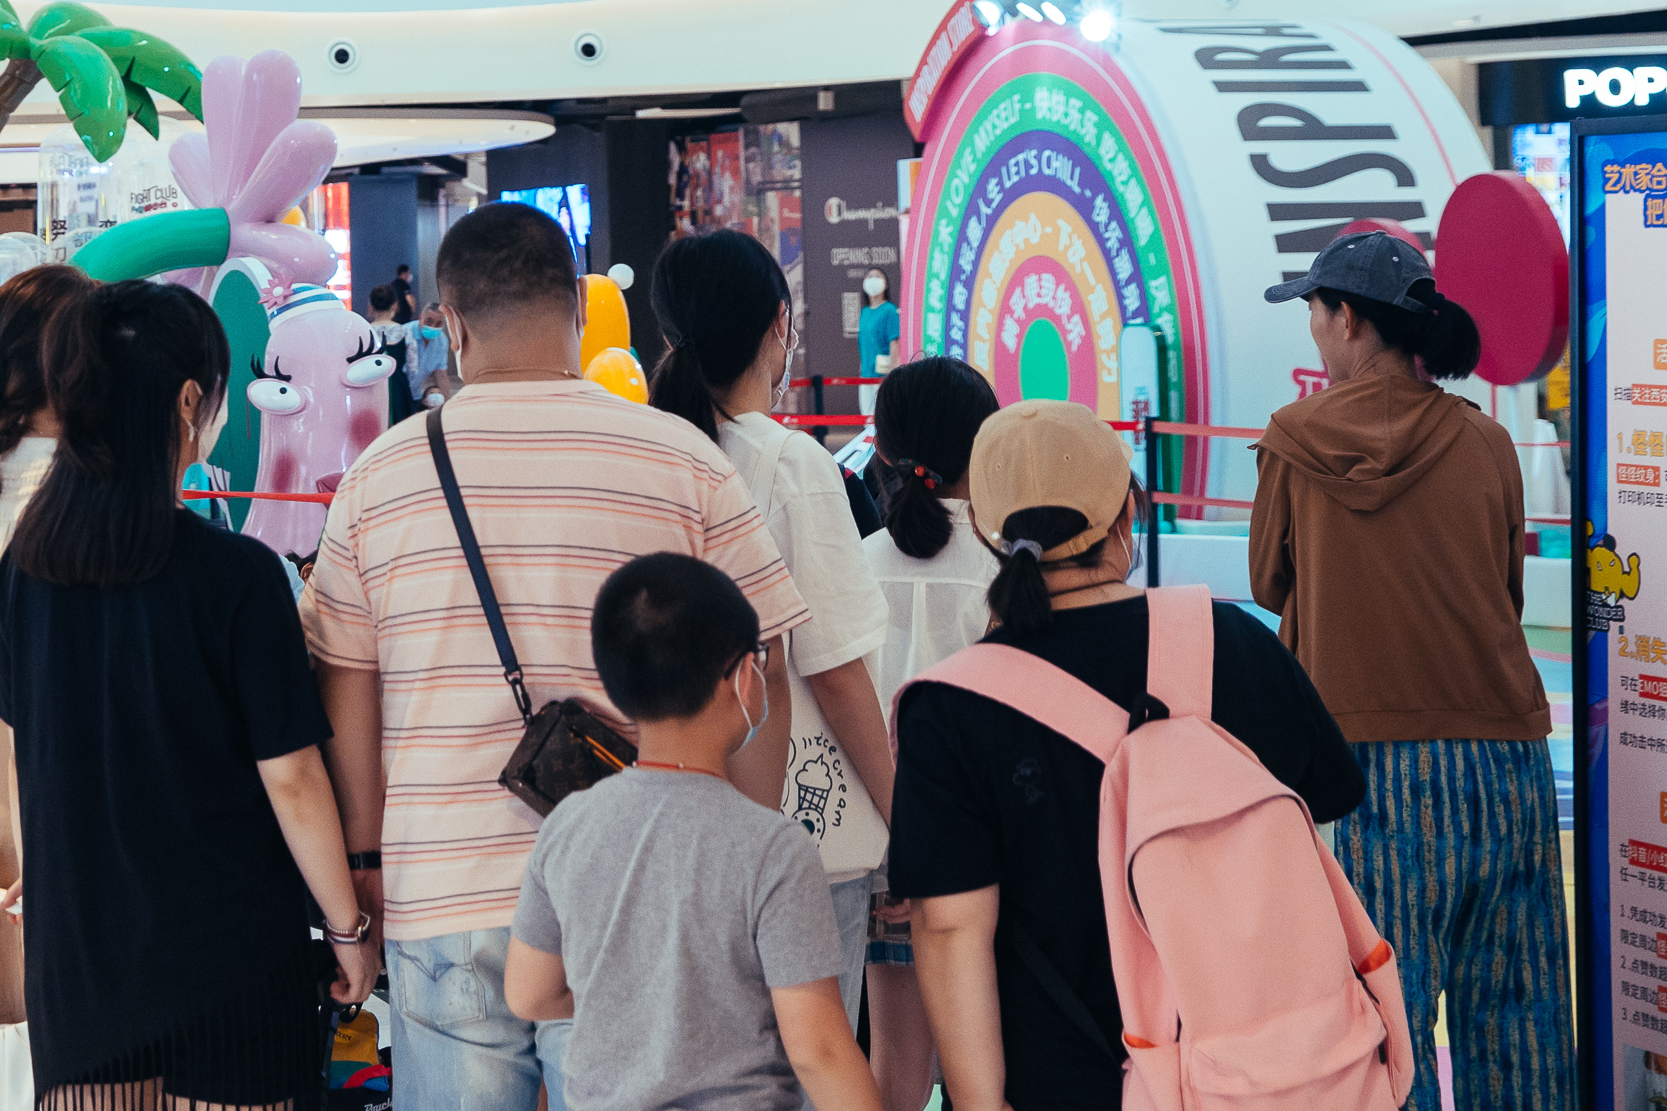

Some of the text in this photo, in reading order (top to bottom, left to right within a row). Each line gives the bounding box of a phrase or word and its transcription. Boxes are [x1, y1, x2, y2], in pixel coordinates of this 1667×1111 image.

[1563, 66, 1667, 109] POP
[945, 146, 978, 217] LOVE
[973, 93, 1021, 158] MYSELF
[1001, 148, 1038, 189] LET'S
[1041, 149, 1081, 194] CHILL
[1603, 163, 1667, 191] 艺术家合
[830, 246, 897, 266] OPENING SOON
[1056, 219, 1119, 383] 下次一定努力
[1617, 429, 1667, 458] 1.怪怪
[1619, 732, 1667, 755] 成功击中所
[814, 732, 847, 827] ice cream
